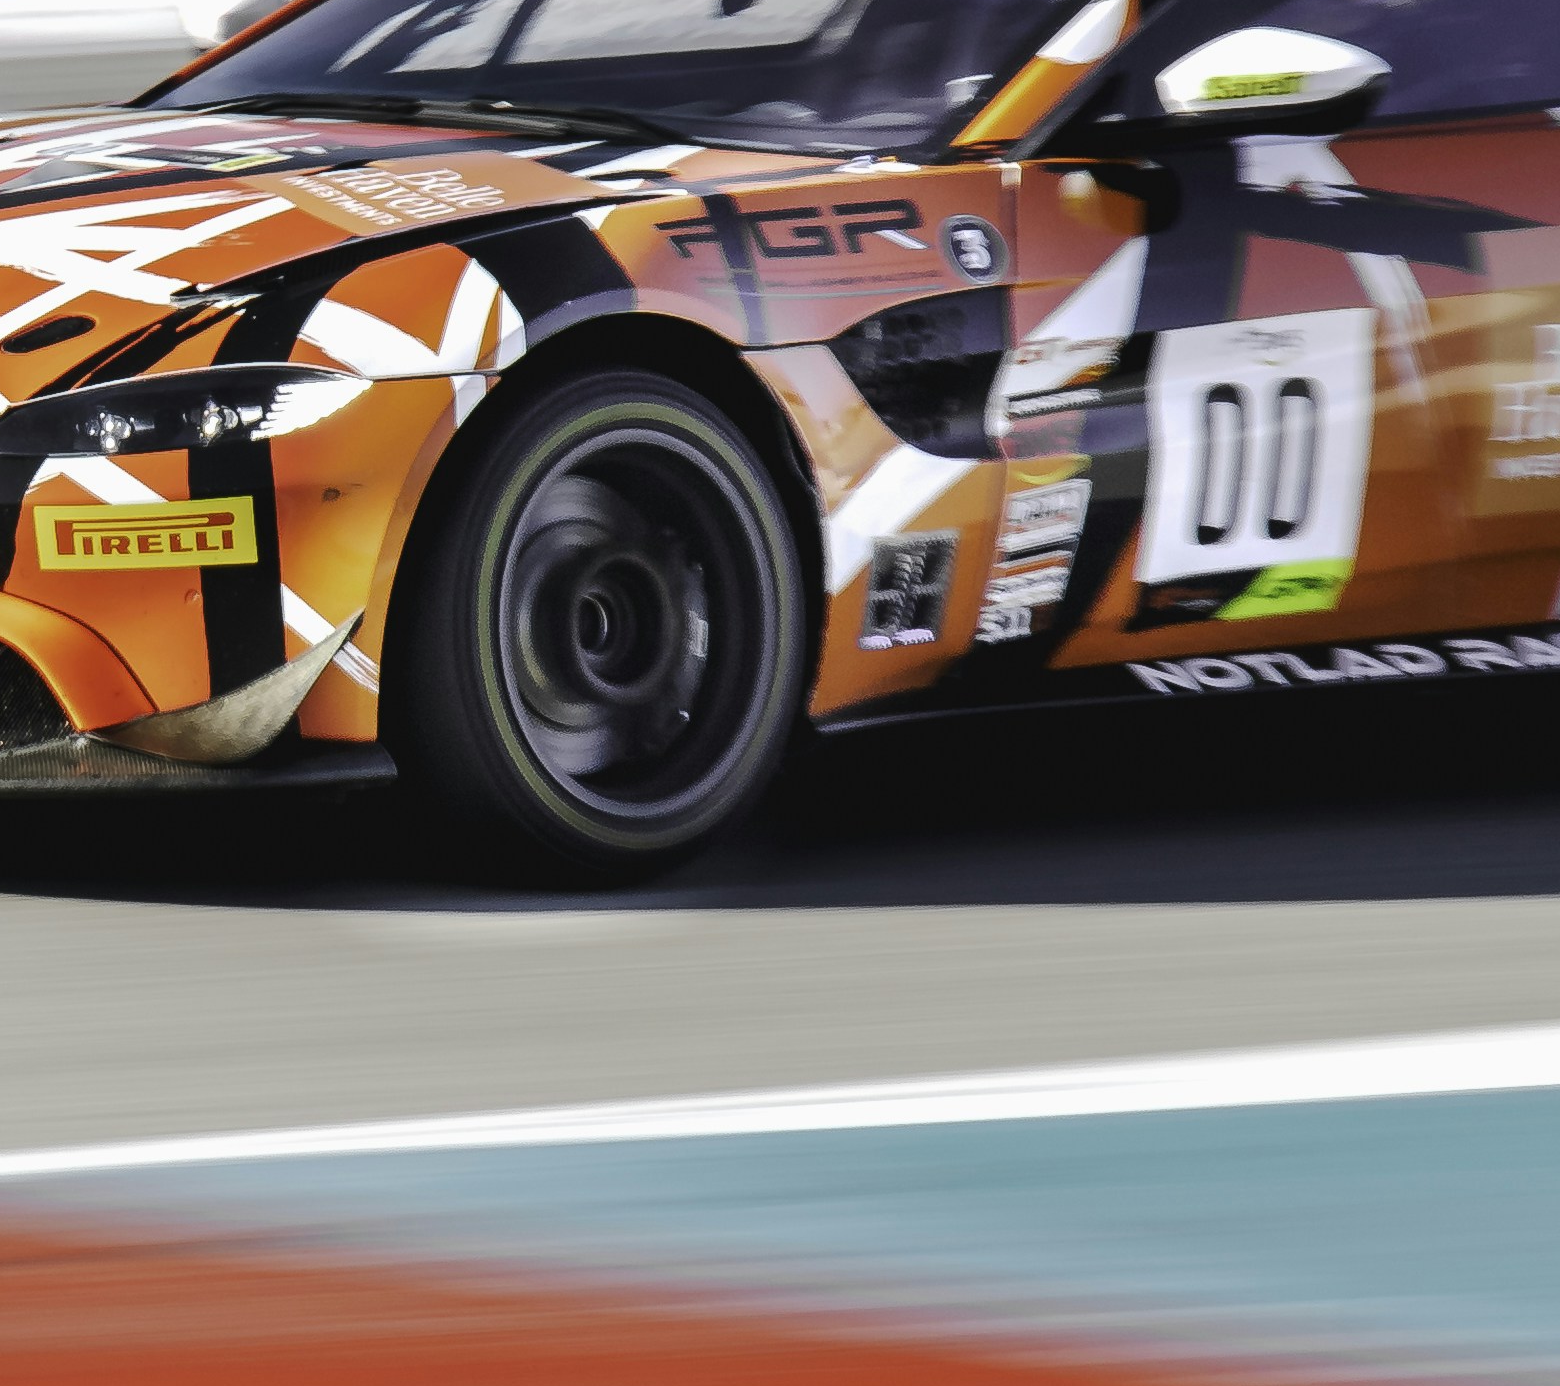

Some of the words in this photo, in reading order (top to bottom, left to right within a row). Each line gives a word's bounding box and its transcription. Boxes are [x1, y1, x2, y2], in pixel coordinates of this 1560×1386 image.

[316, 166, 457, 219] Haven
[1190, 375, 1328, 547] 00
[54, 511, 235, 556] PIRELLI
[1127, 643, 1447, 696] NOTLAD
